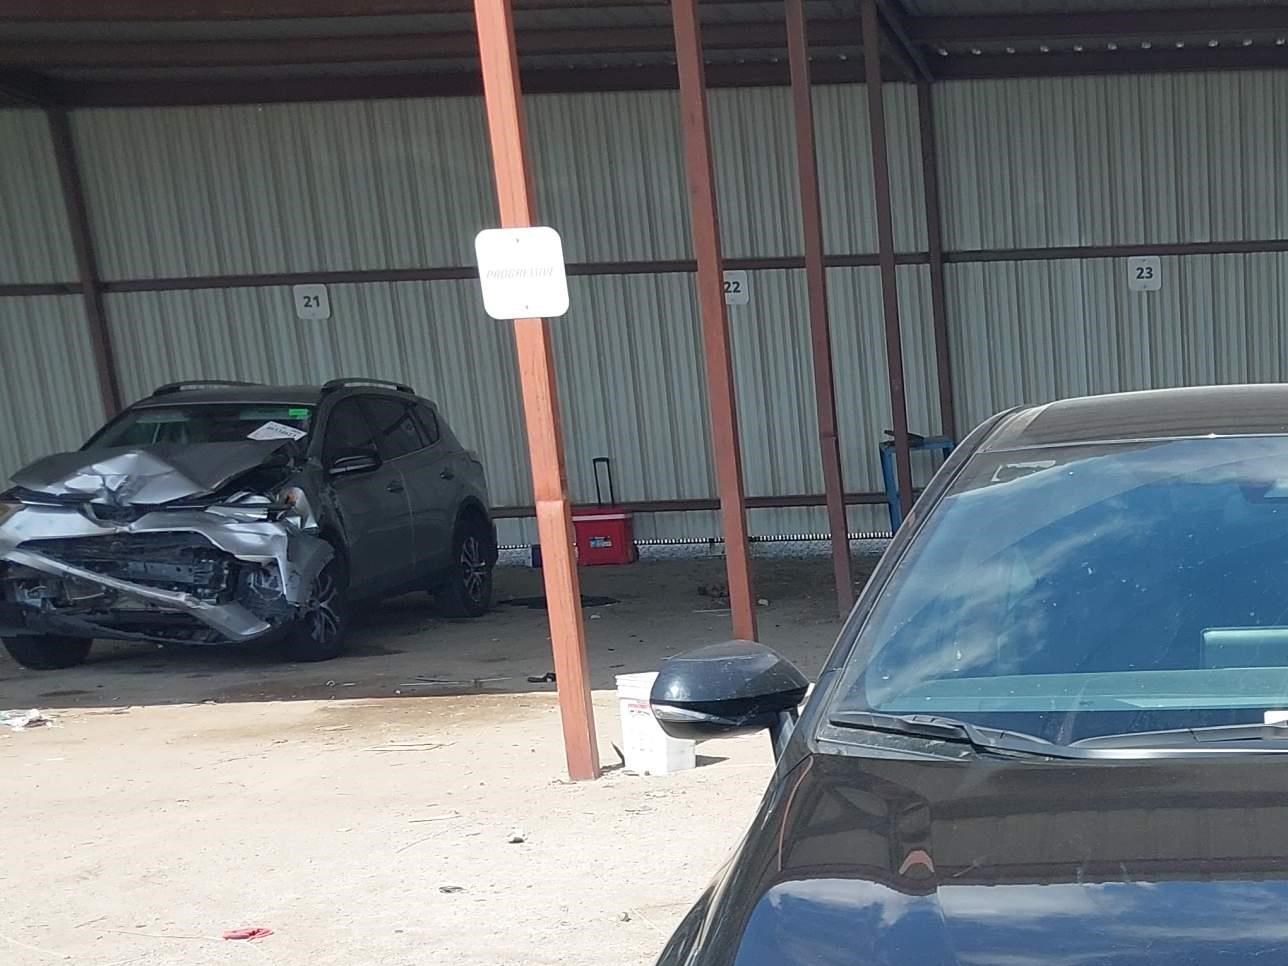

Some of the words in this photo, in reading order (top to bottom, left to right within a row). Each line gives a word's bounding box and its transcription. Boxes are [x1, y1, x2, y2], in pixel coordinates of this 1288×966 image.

[1136, 267, 1153, 280] 23
[723, 281, 741, 293] 22
[303, 295, 320, 308] 21
